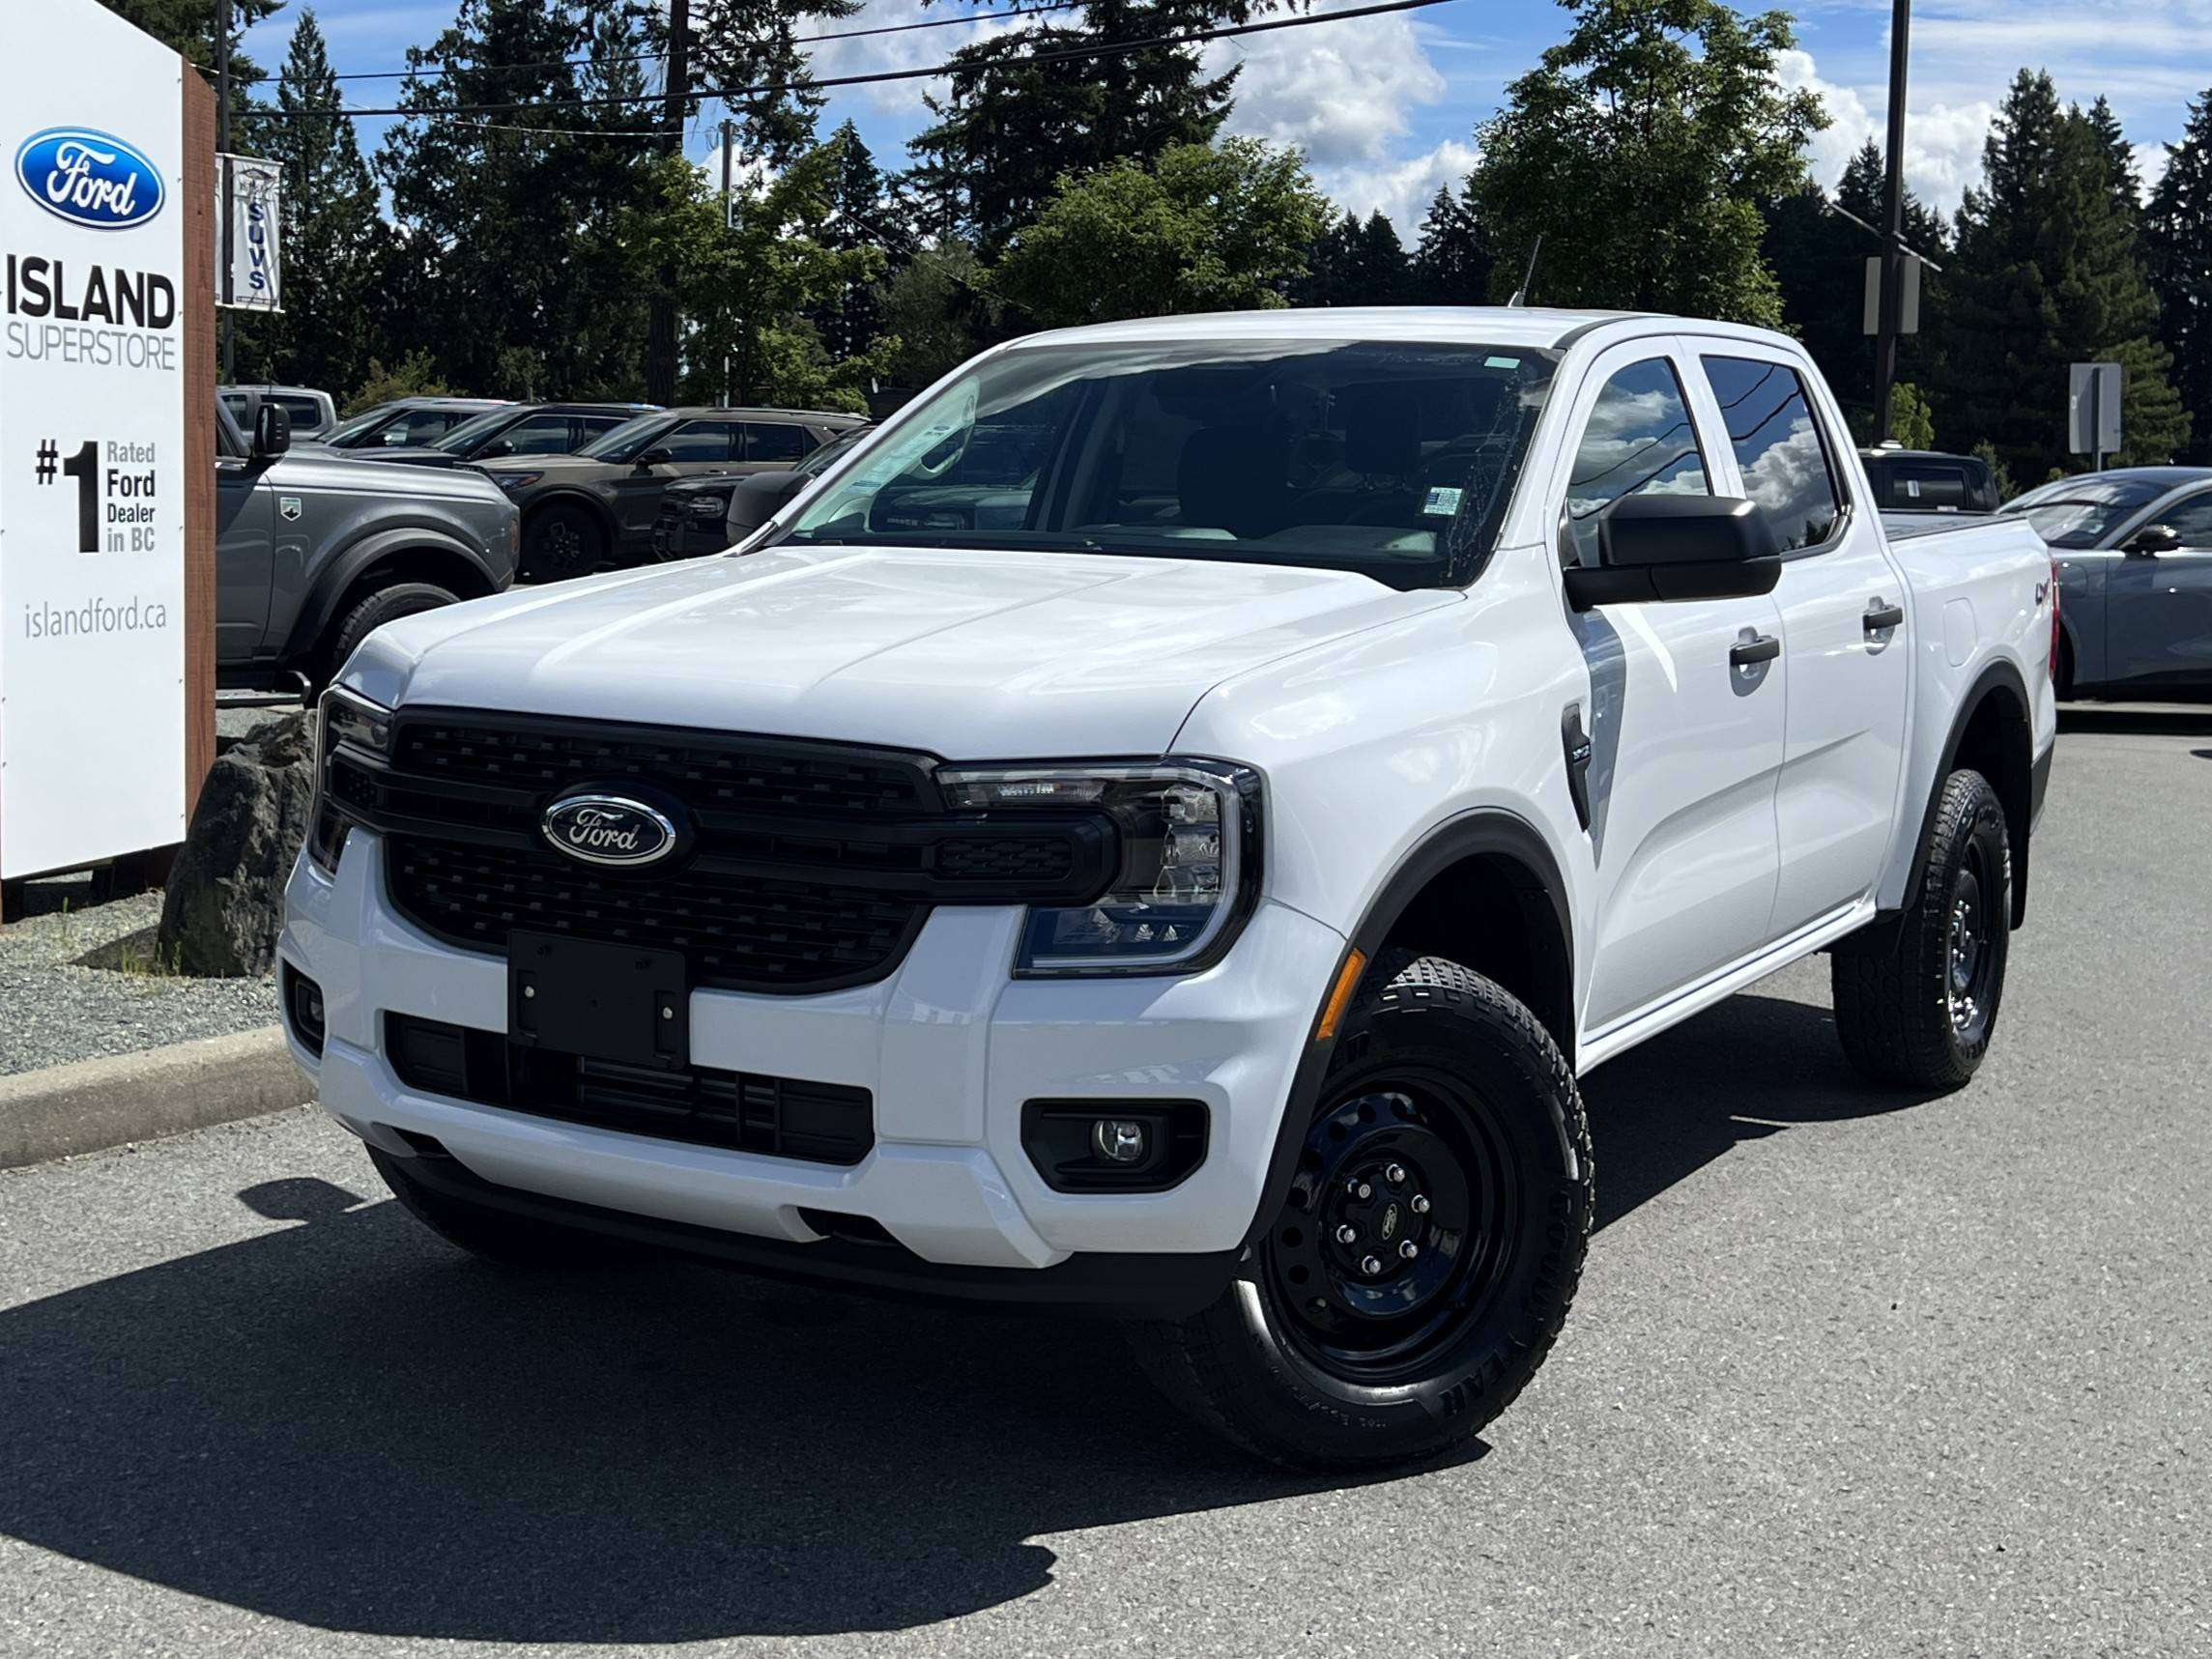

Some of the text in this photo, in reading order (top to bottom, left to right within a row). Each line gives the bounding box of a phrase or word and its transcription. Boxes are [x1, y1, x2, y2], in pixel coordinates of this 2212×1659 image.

[46, 141, 137, 216] Ford
[248, 203, 265, 290] SUVS
[6, 253, 176, 329] ISLAND
[6, 321, 176, 371] SUPERSTORE
[106, 441, 156, 463] Rated
[35, 439, 100, 553] #1
[106, 469, 156, 497] Ford
[106, 503, 155, 523] Dealer
[106, 528, 155, 552] in BC
[25, 595, 166, 638] islandford.ca
[569, 809, 641, 850] Ford
